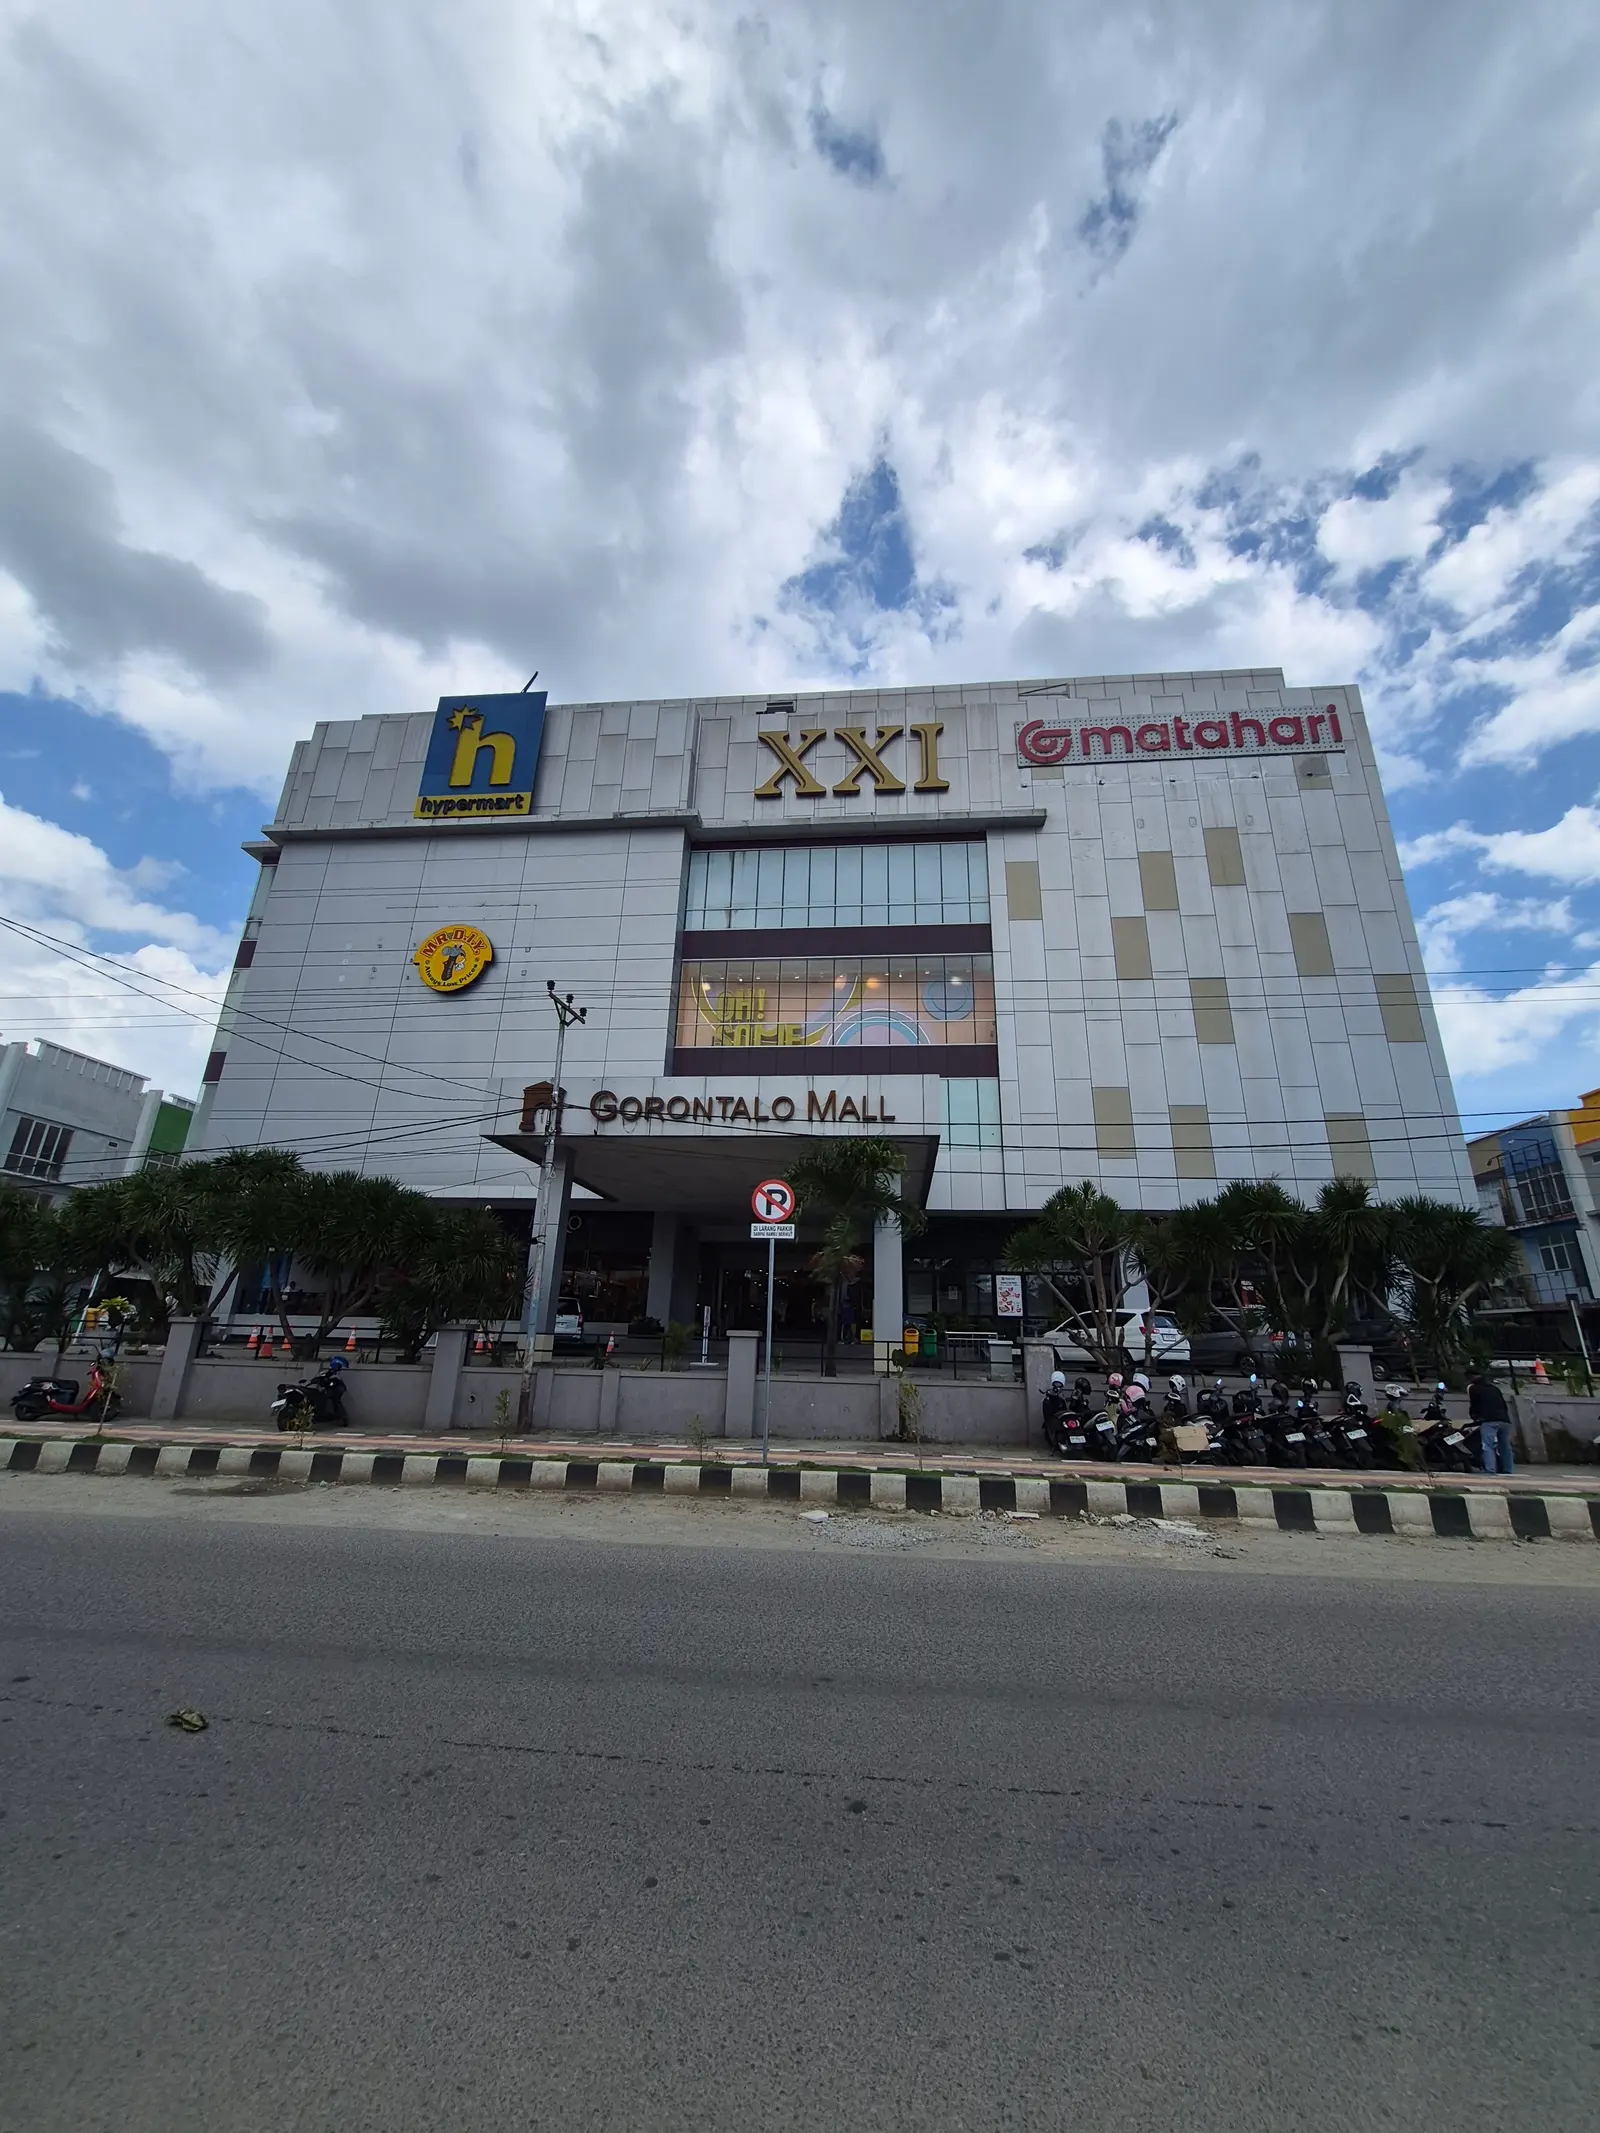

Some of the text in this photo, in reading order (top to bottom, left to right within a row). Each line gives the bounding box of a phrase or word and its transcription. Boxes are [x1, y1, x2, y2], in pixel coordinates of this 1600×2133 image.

[1080, 704, 1343, 755] matahari
[754, 723, 950, 797] XXI
[420, 793, 525, 815] hypermart
[459, 964, 478, 983] Prices
[716, 988, 766, 1022] OH!
[590, 1089, 896, 1122] GORONTALO MALL
[766, 1189, 787, 1215] P
